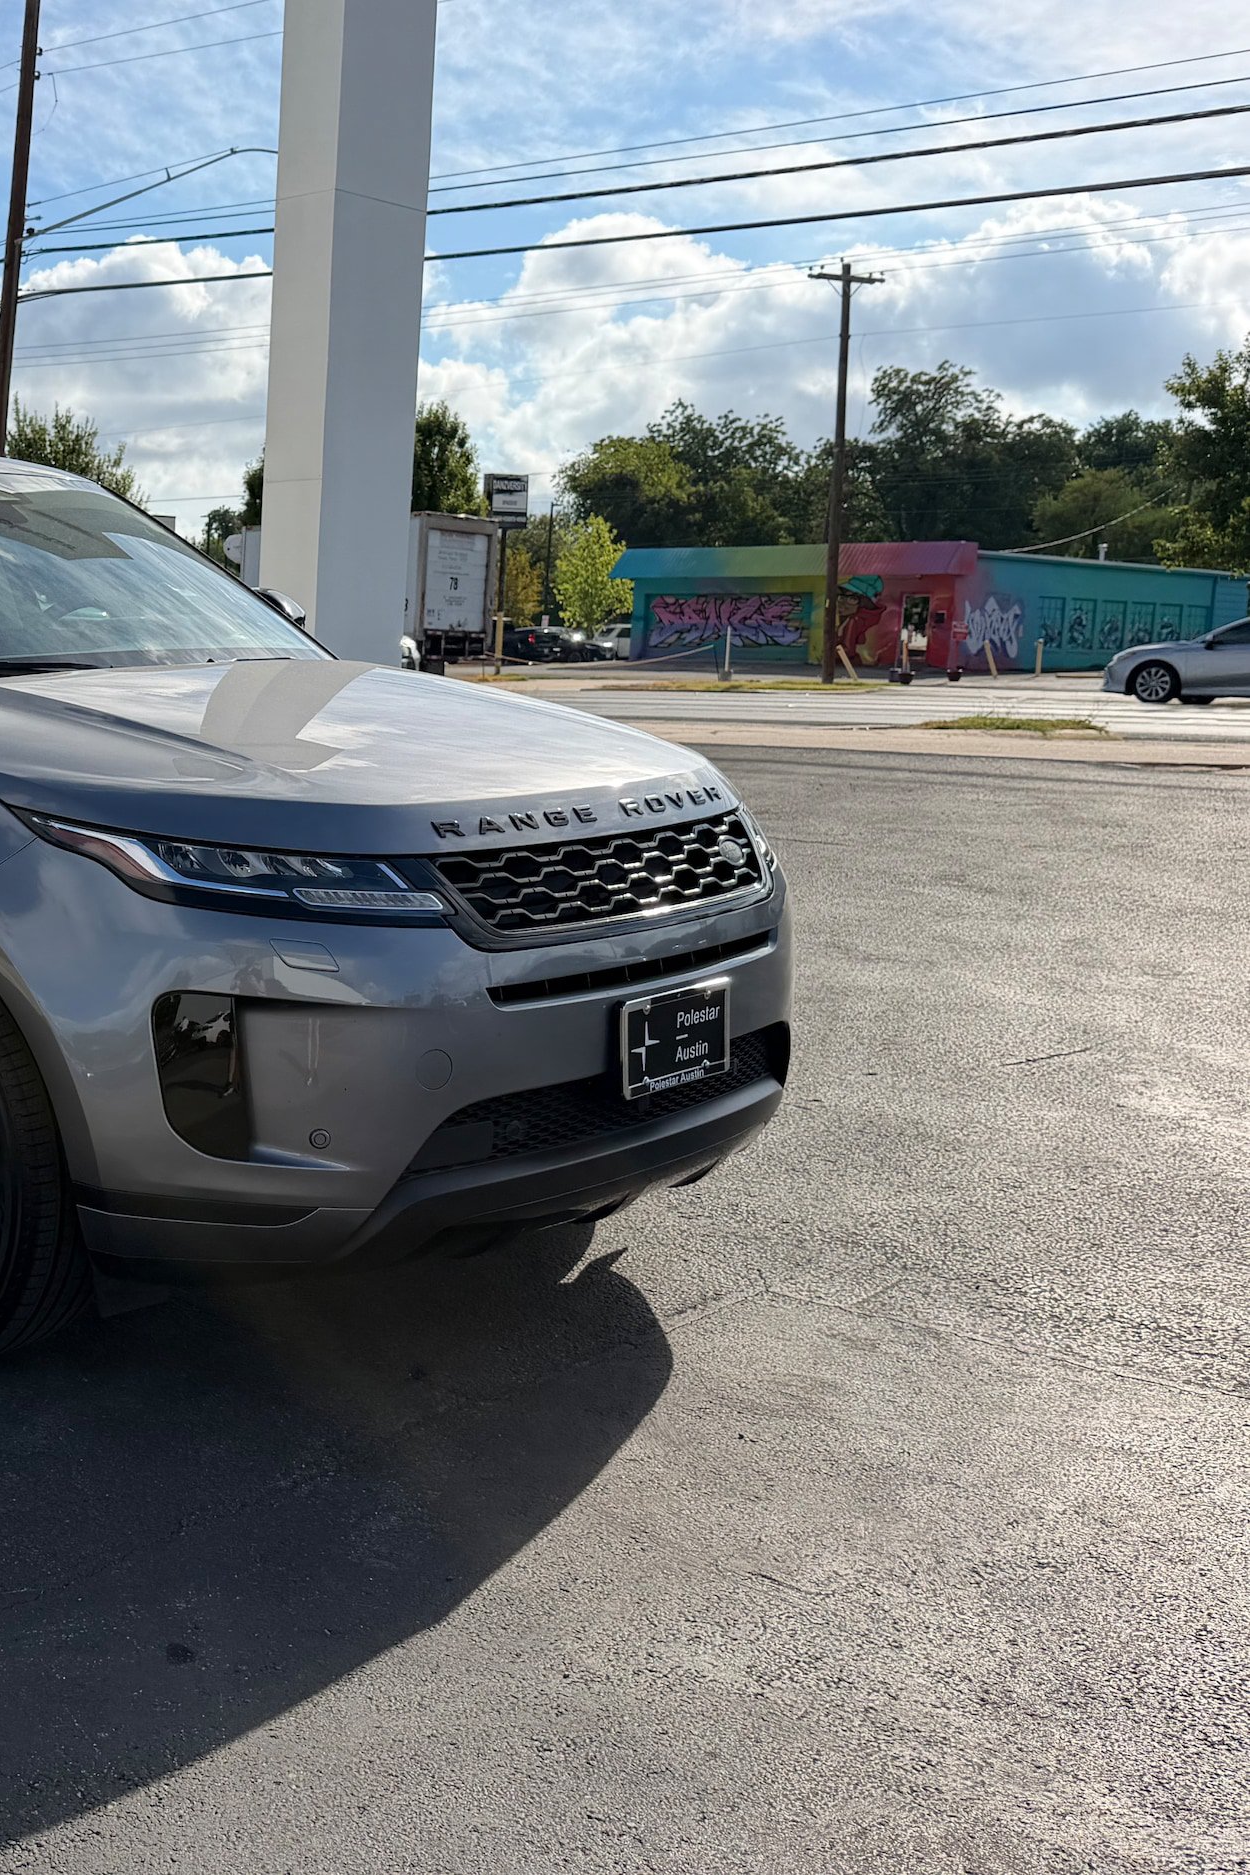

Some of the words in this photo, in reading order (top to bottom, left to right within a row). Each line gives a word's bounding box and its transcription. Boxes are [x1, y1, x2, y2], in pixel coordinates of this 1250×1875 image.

[449, 576, 459, 591] 78
[430, 803, 598, 838] RANGE
[618, 786, 723, 818] ROVER
[676, 1005, 720, 1029] Polestar
[675, 1040, 708, 1063] Austin
[649, 1076, 679, 1092] Polestar
[680, 1068, 705, 1083] Austin
